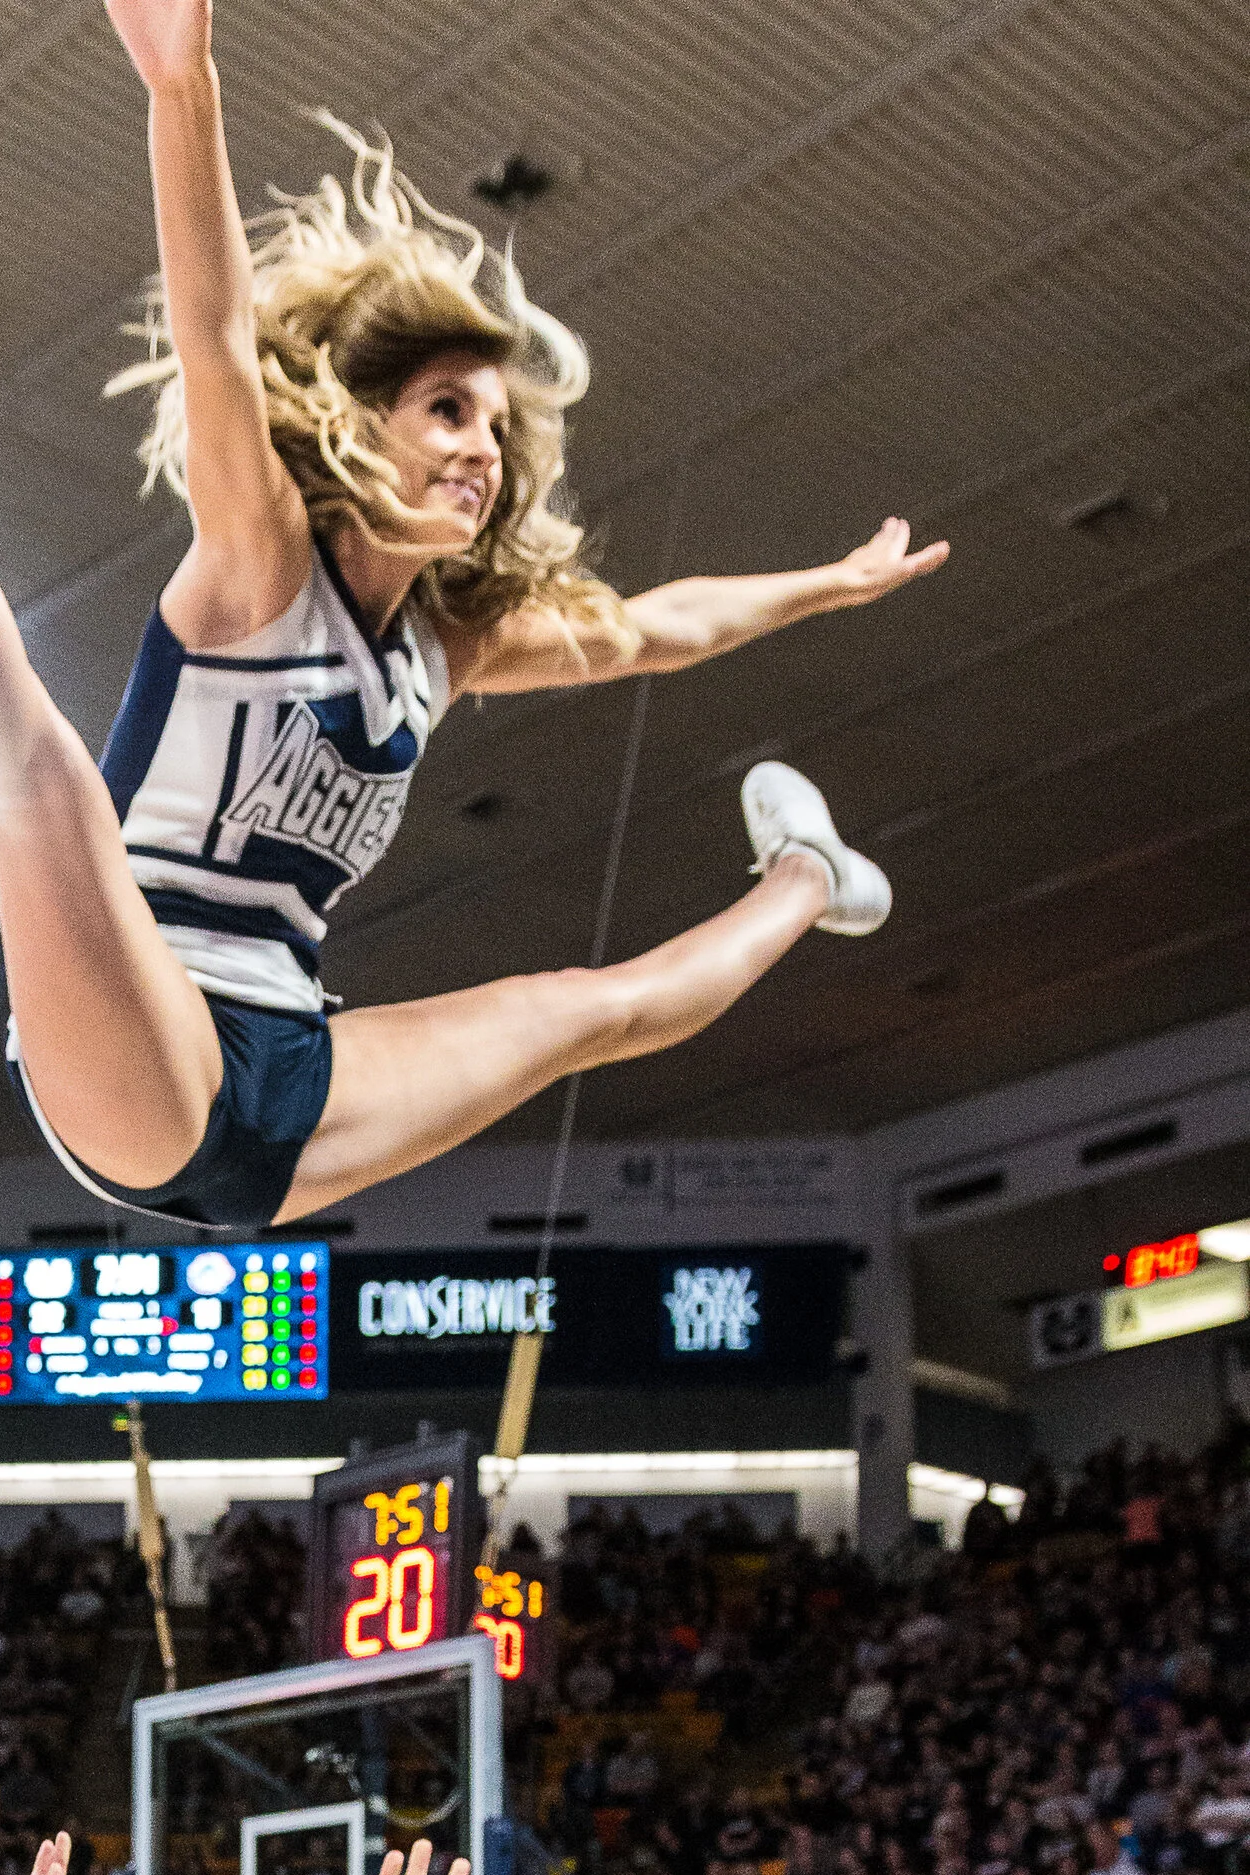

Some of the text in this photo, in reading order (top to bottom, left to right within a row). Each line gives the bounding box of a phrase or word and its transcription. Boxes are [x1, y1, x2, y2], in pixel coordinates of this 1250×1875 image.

[223, 703, 412, 879] AGGIE
[358, 1275, 558, 1340] CONSERVICE
[661, 1290, 761, 1325] YORK
[673, 1266, 751, 1294] NEW
[674, 1320, 751, 1352] LIFE
[364, 1481, 450, 1546] 7:51
[344, 1547, 435, 1659] 20
